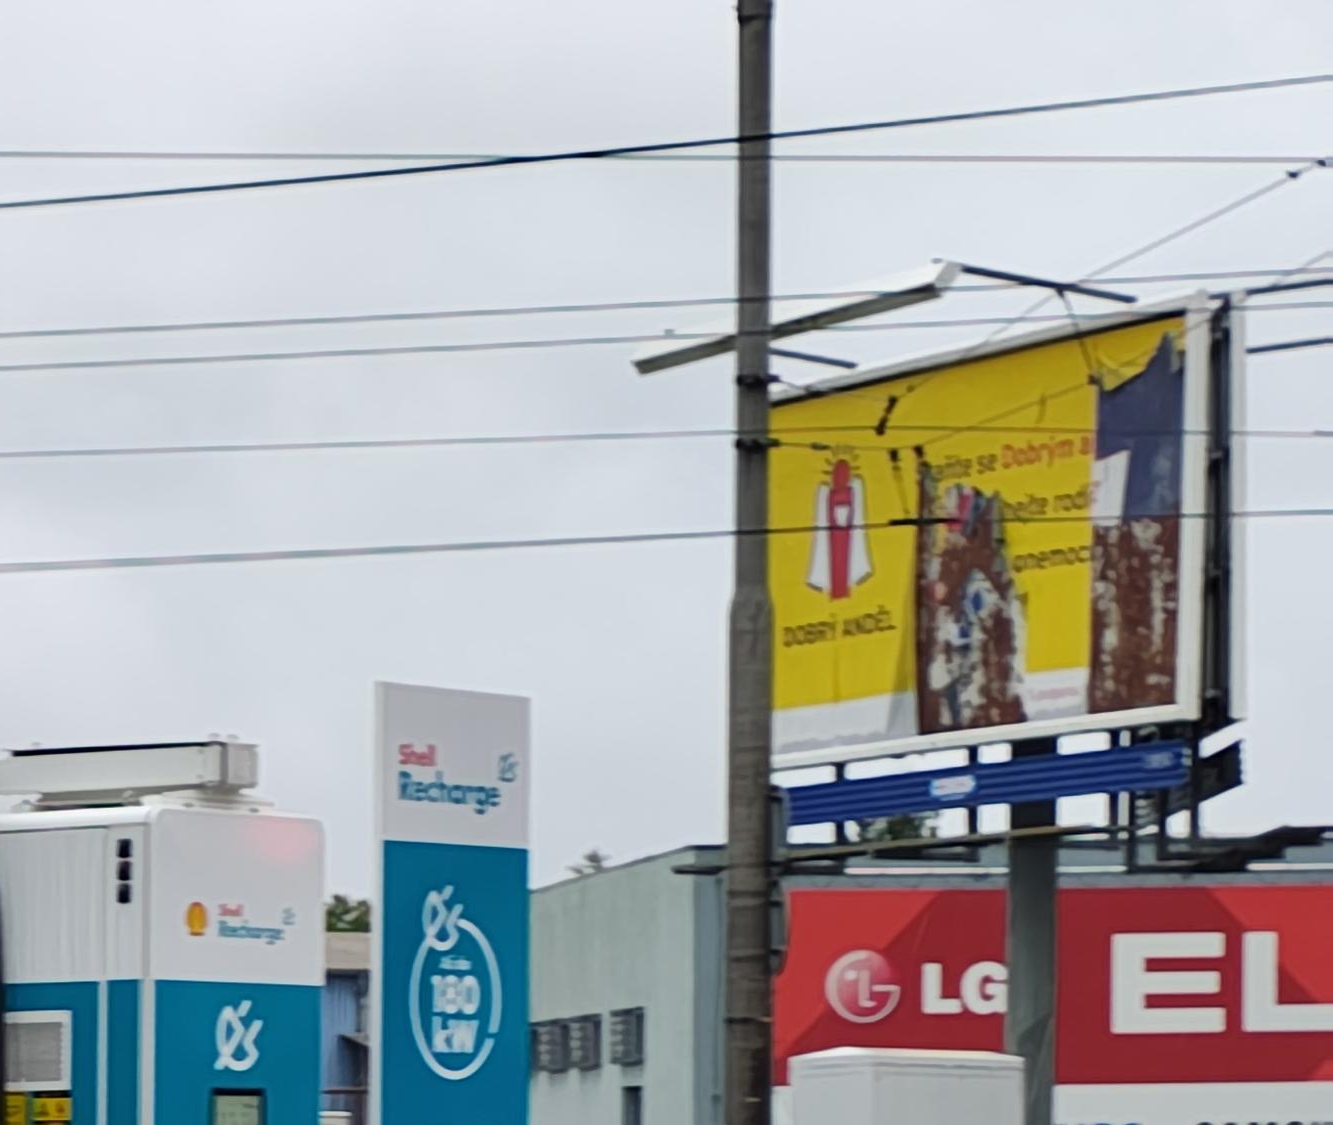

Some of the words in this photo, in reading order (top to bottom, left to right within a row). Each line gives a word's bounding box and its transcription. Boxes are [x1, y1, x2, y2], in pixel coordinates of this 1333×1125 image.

[1002, 435, 1074, 469] Dobrým
[783, 612, 836, 647] DOBRÝ
[921, 961, 1009, 1015] LG
[432, 1016, 480, 1053] kW
